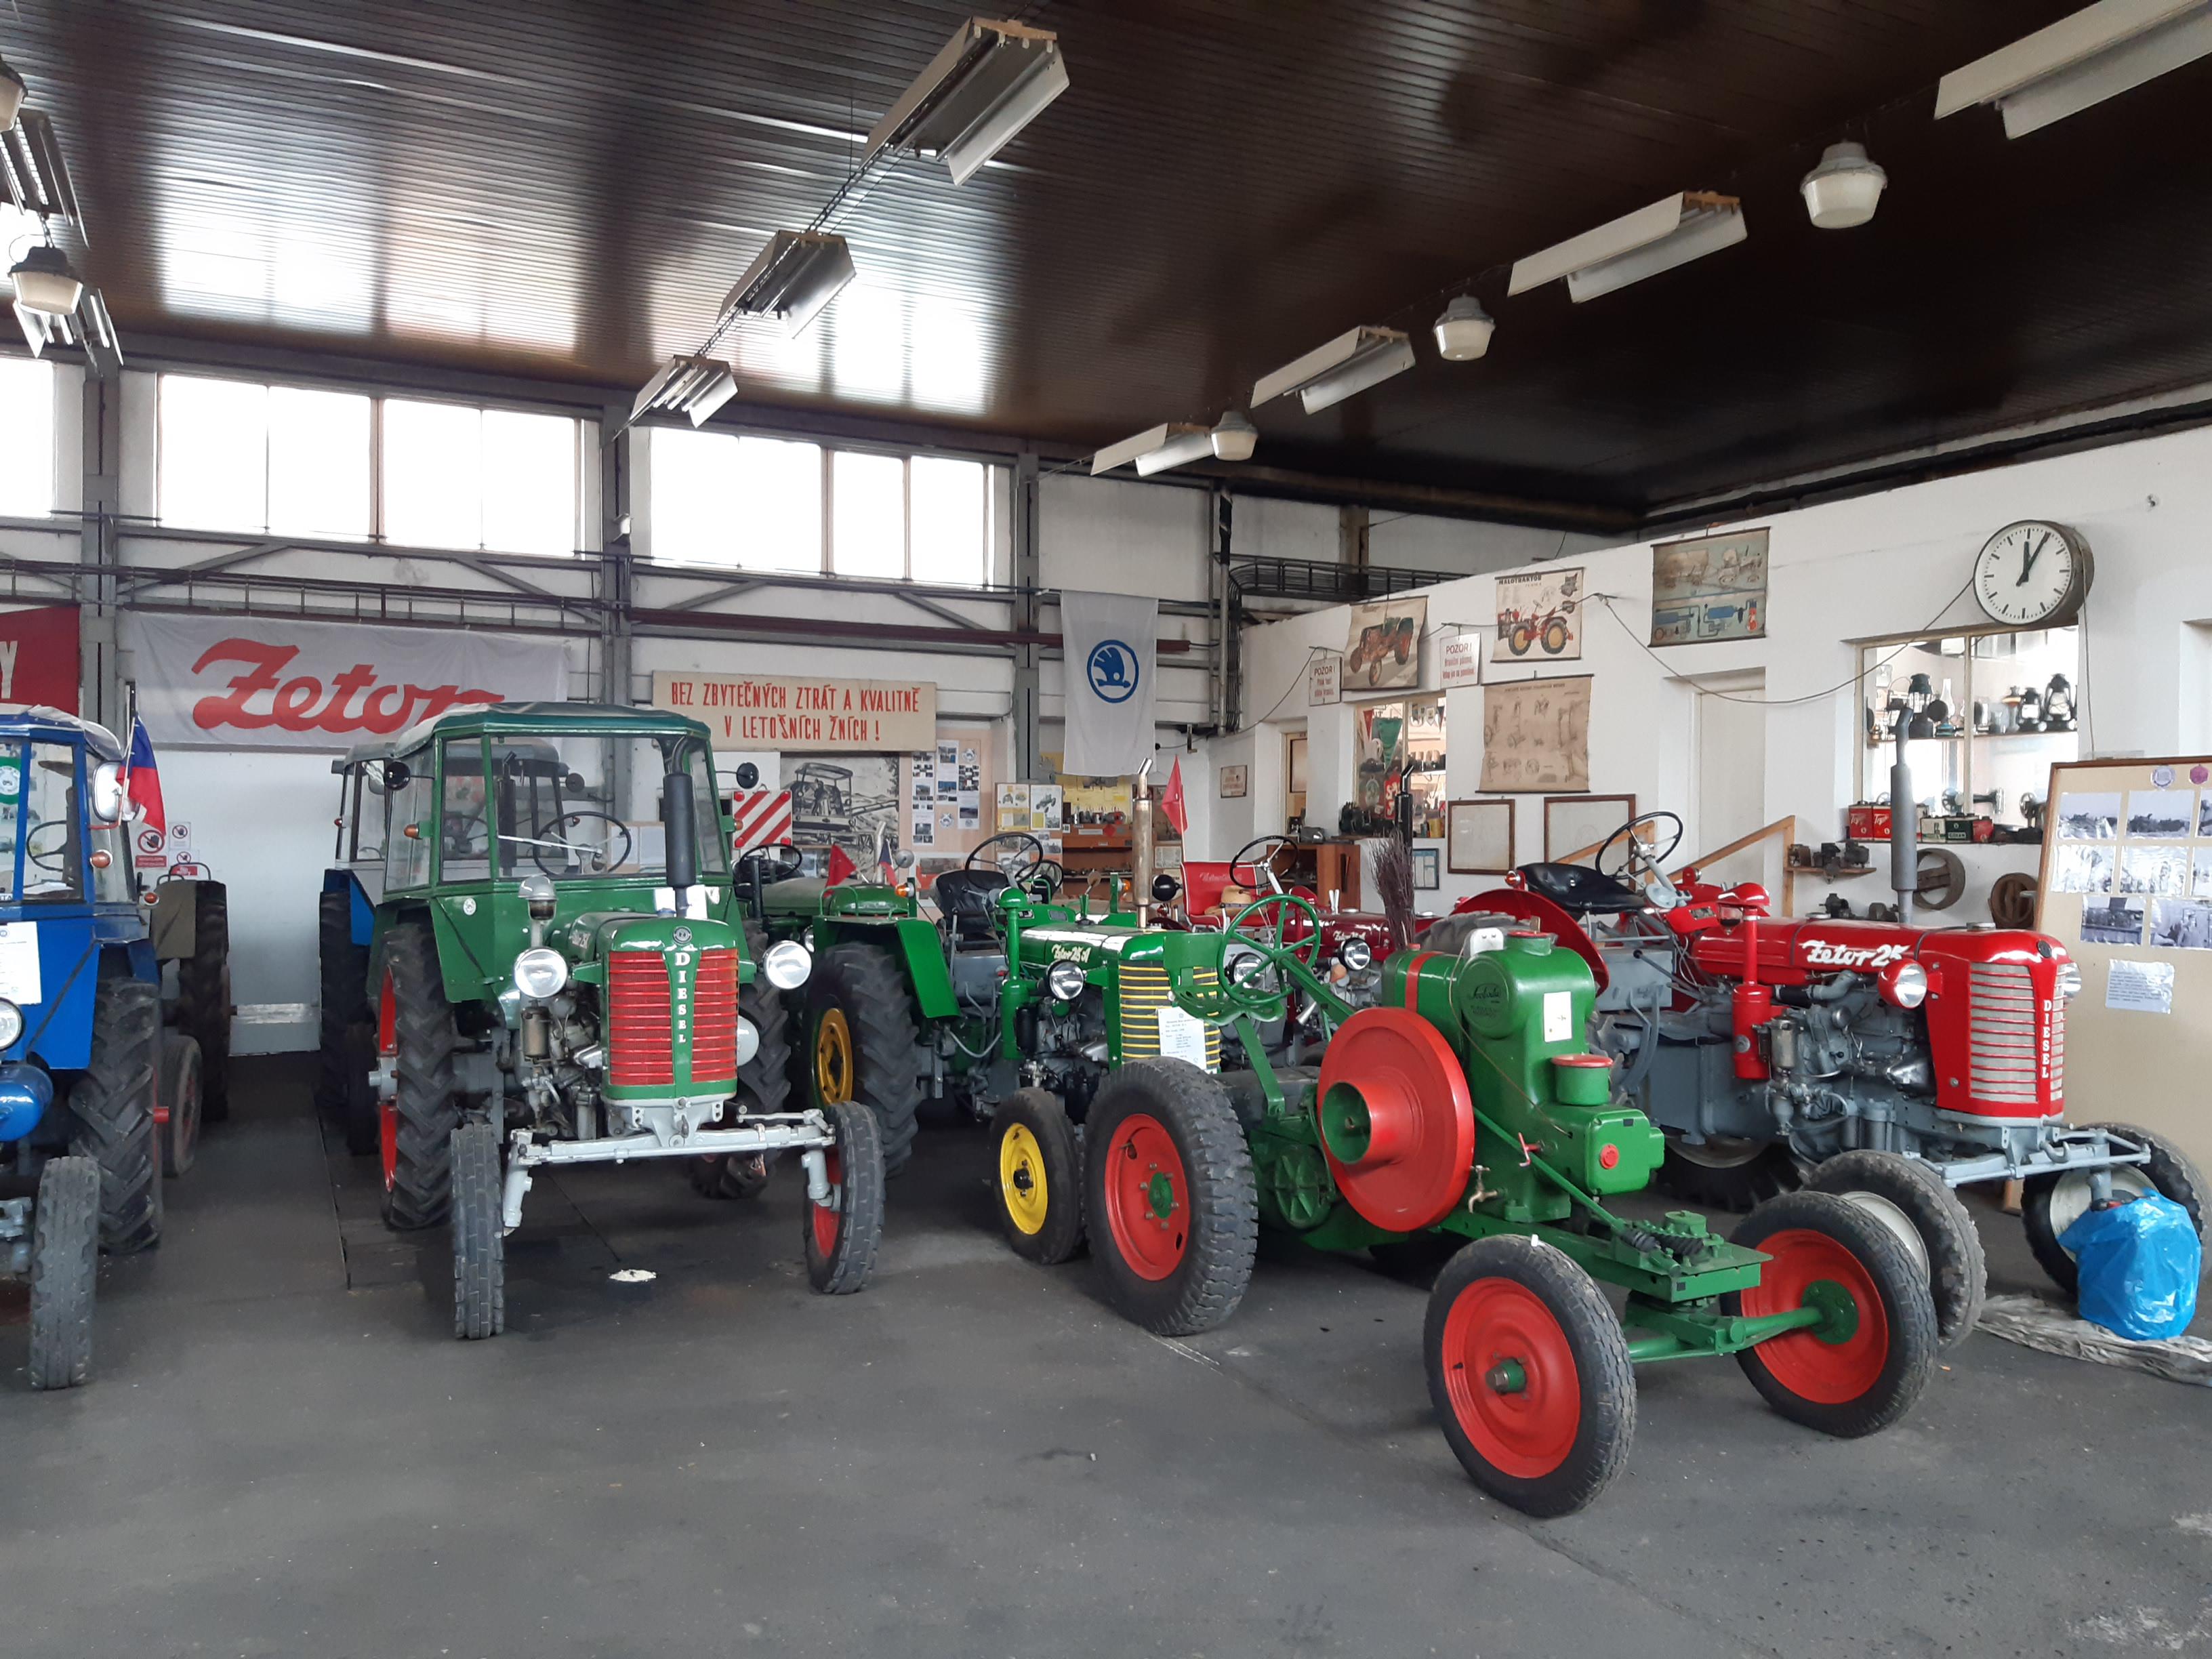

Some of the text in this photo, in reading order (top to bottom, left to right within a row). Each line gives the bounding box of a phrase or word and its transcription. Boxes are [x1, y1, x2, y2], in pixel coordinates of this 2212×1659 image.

[1446, 643, 1469, 655] POZOR
[1314, 665, 1332, 676] POZOR
[192, 637, 505, 734] Zetor
[672, 681, 921, 712] BEZ ZBYTEČNÝCH ZTRÁT A KVALITNĚ
[724, 714, 880, 741] V LETOŠNÍCH ŽNÍCH !
[1052, 943, 1073, 960] Zetor
[1802, 939, 1877, 966] Zetor
[675, 952, 691, 1043] DIESEL
[2042, 1000, 2052, 1078] DIESEL
